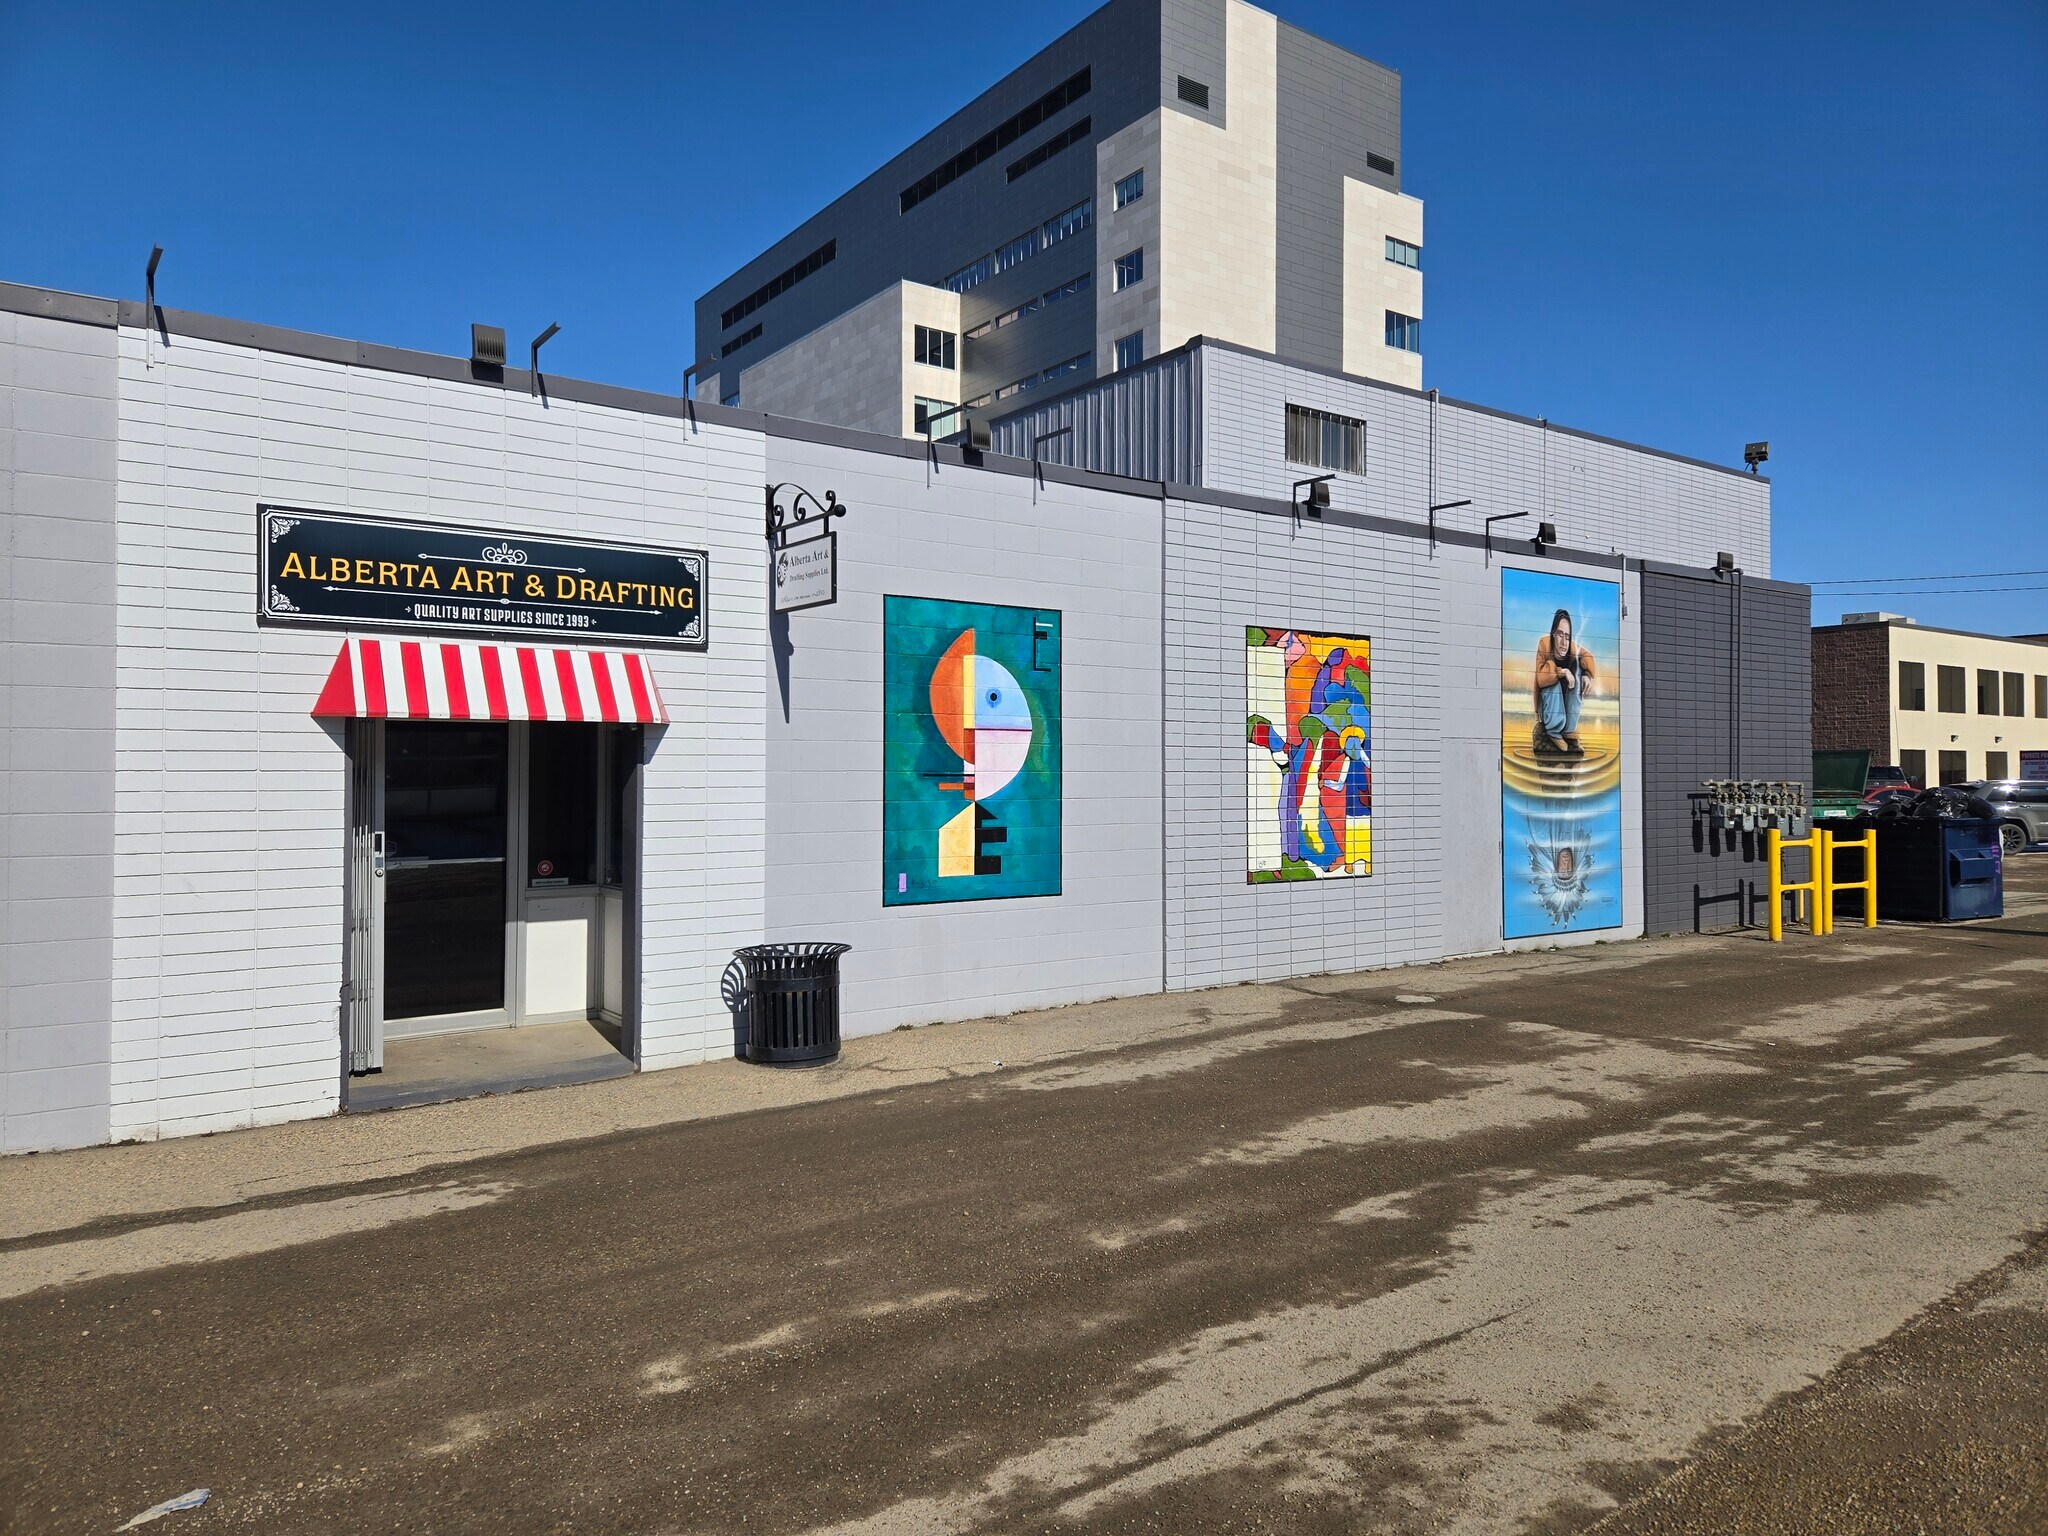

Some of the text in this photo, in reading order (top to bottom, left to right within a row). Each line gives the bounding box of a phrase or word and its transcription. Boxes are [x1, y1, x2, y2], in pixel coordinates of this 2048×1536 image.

[790, 549, 829, 567] Alberta Art &
[279, 552, 694, 609] ALBERTA ART & DRAFTING
[414, 603, 589, 628] QUALITY ART SUPPLIES SINCE 1993
